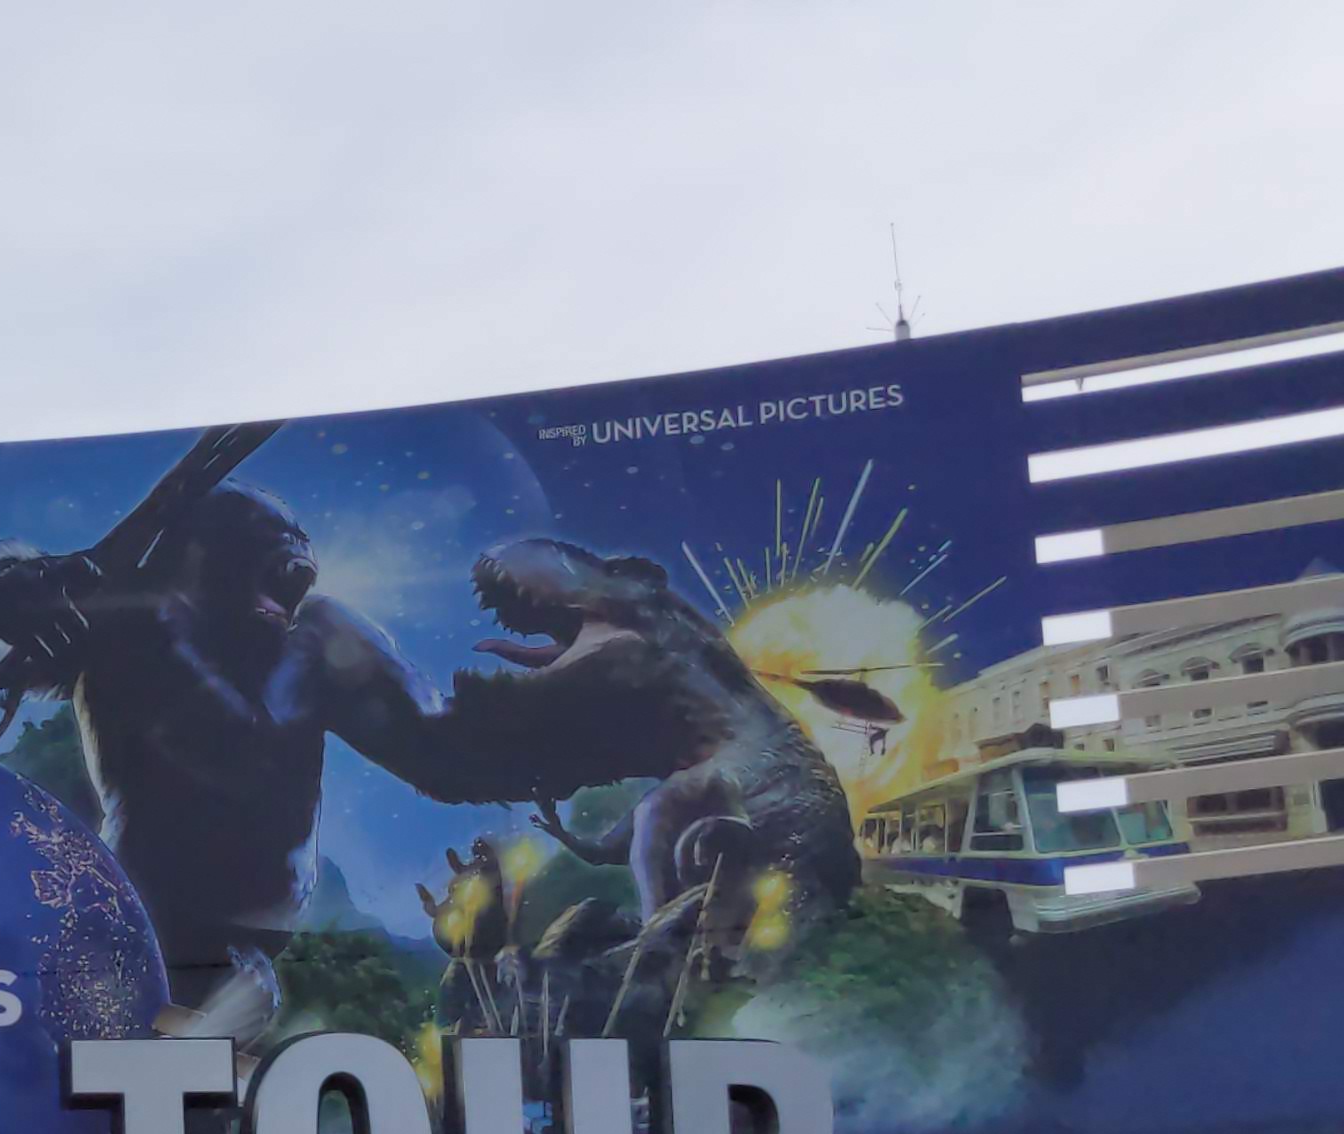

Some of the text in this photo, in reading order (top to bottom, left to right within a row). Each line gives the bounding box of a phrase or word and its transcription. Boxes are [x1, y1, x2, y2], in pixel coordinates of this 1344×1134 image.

[592, 384, 904, 444] UNIVERSAL PICTURES
[538, 424, 586, 440] INSPIRED
[572, 435, 587, 447] BY
